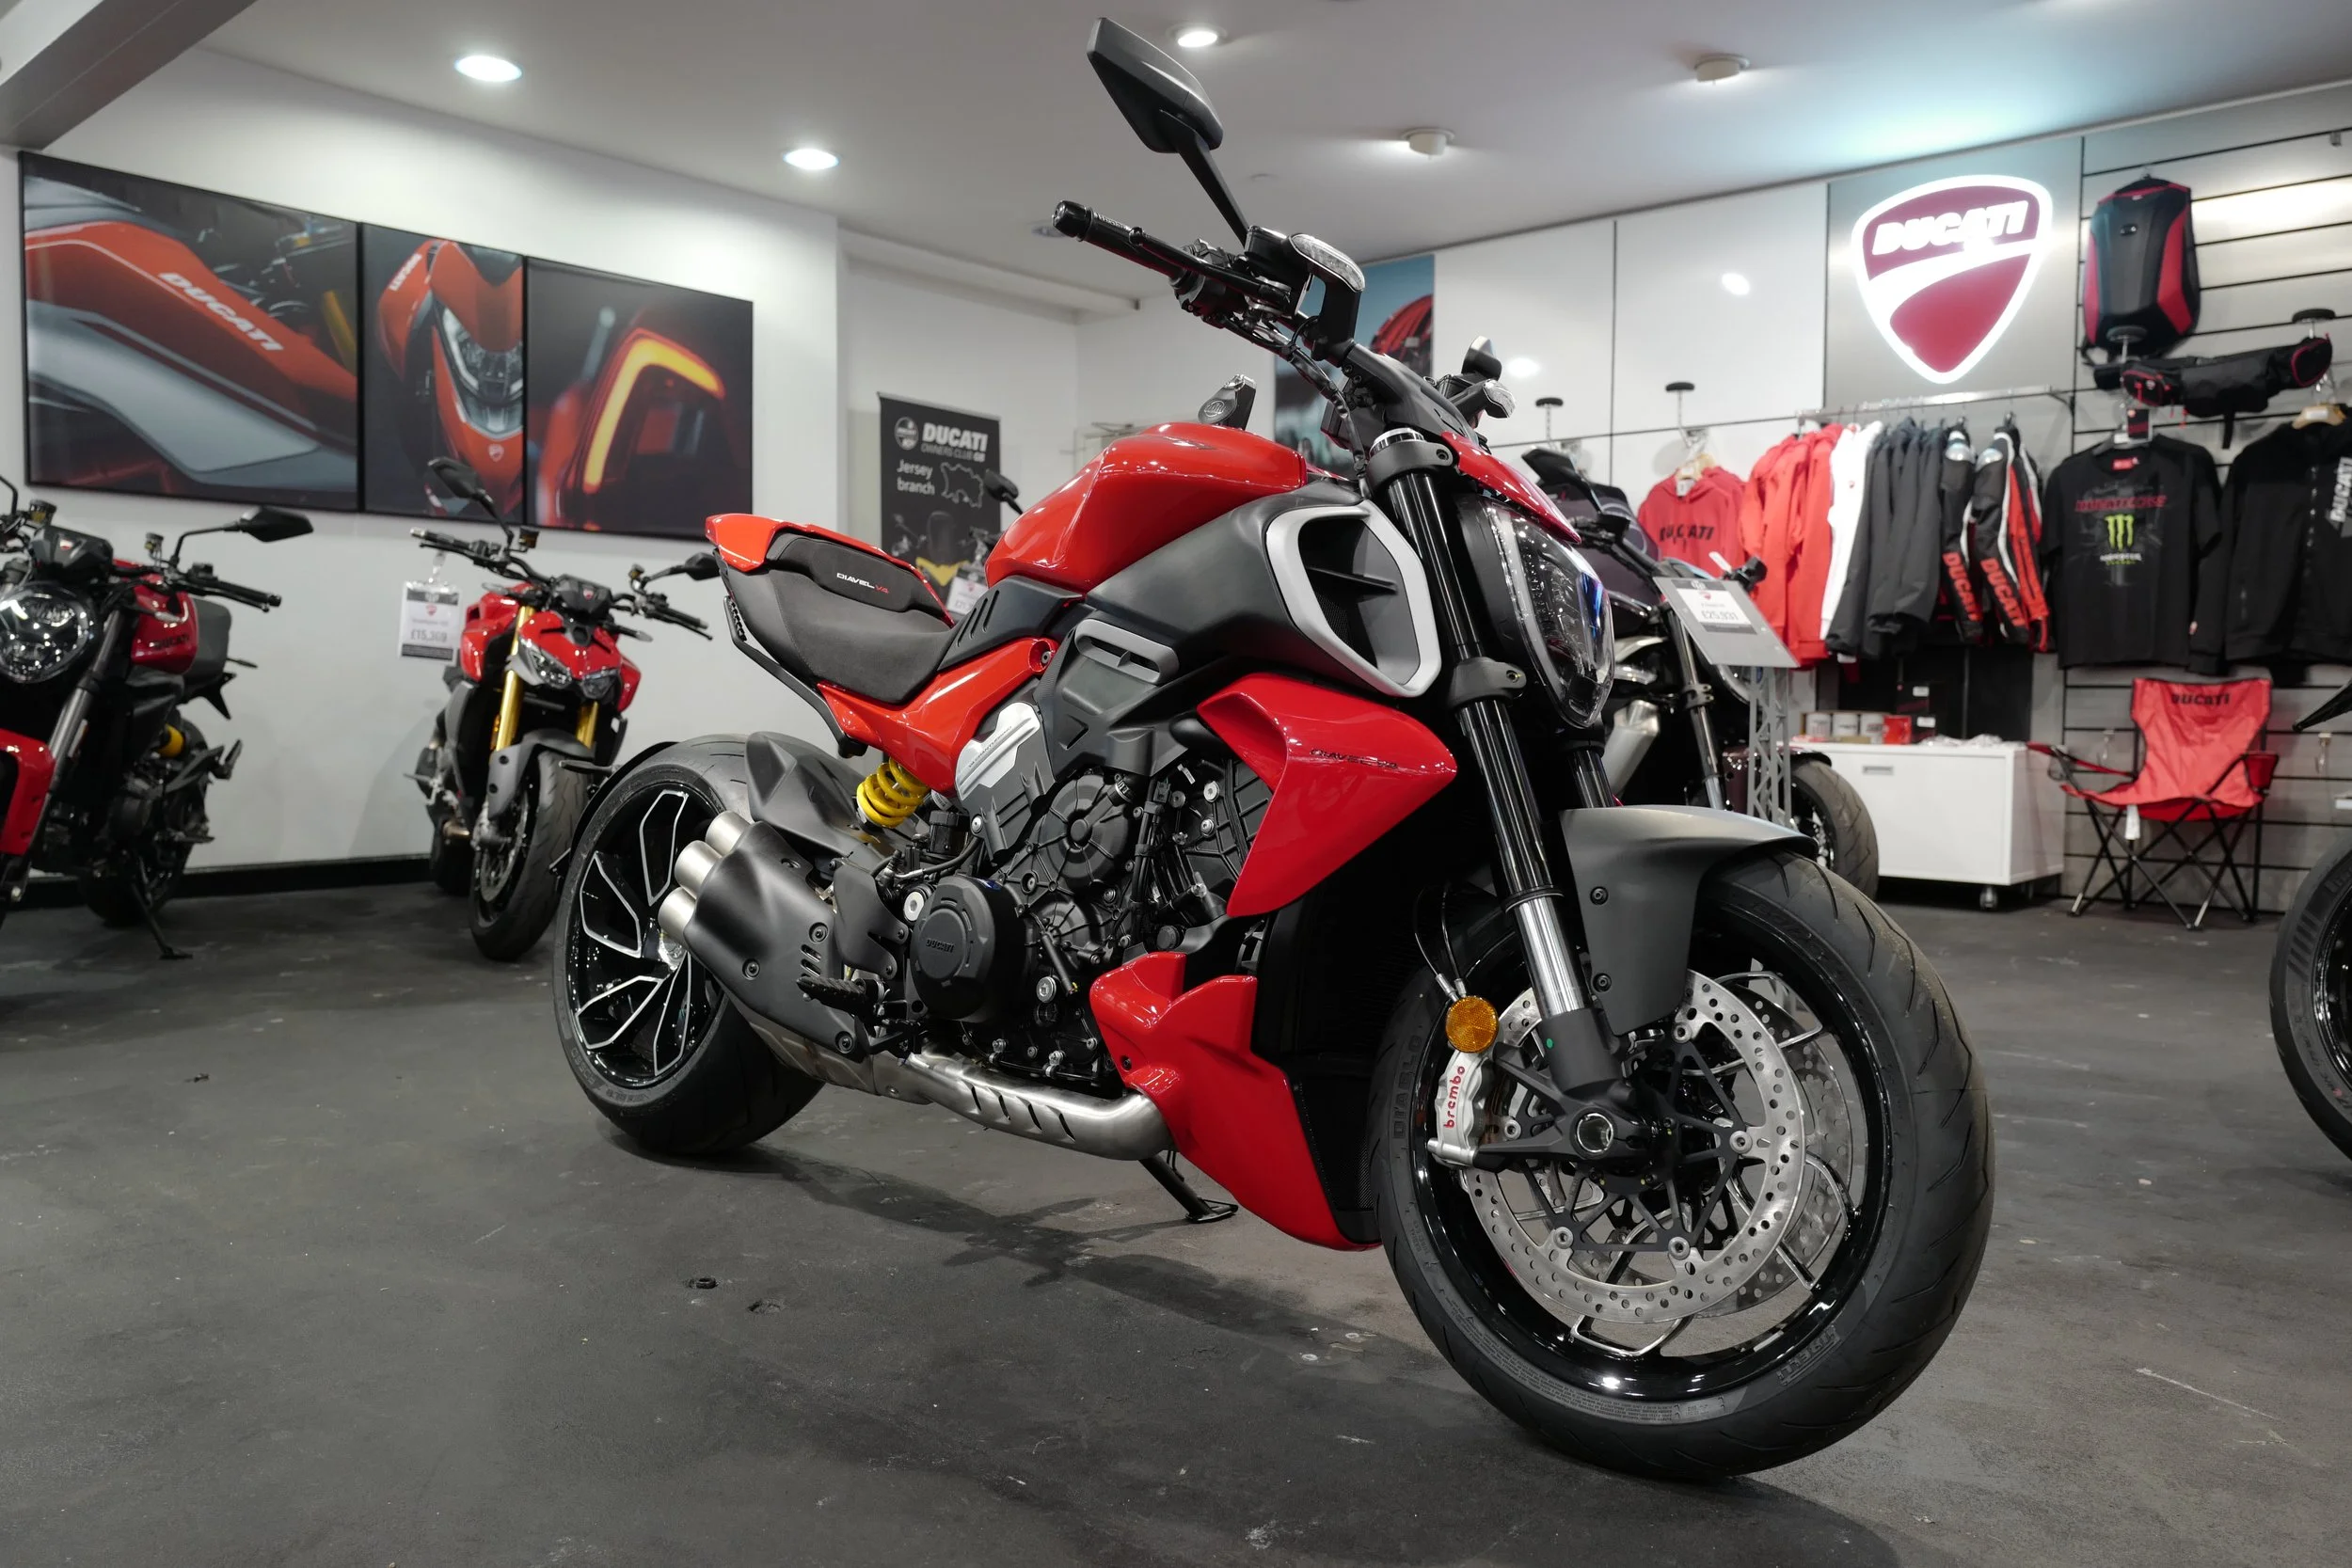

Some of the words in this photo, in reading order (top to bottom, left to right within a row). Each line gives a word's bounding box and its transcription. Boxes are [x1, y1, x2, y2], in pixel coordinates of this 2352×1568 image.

[1871, 199, 2029, 256] DUCATI
[158, 272, 284, 351] DUCATI
[922, 421, 989, 452] DUCATI
[897, 459, 933, 481] Jersey
[897, 477, 935, 496] branch
[836, 572, 875, 590] DIAVEL
[875, 584, 889, 594] V4
[1979, 558, 2026, 626] DUCATI
[925, 938, 956, 953] DUCATI
[1443, 1065, 1466, 1130] brembo
